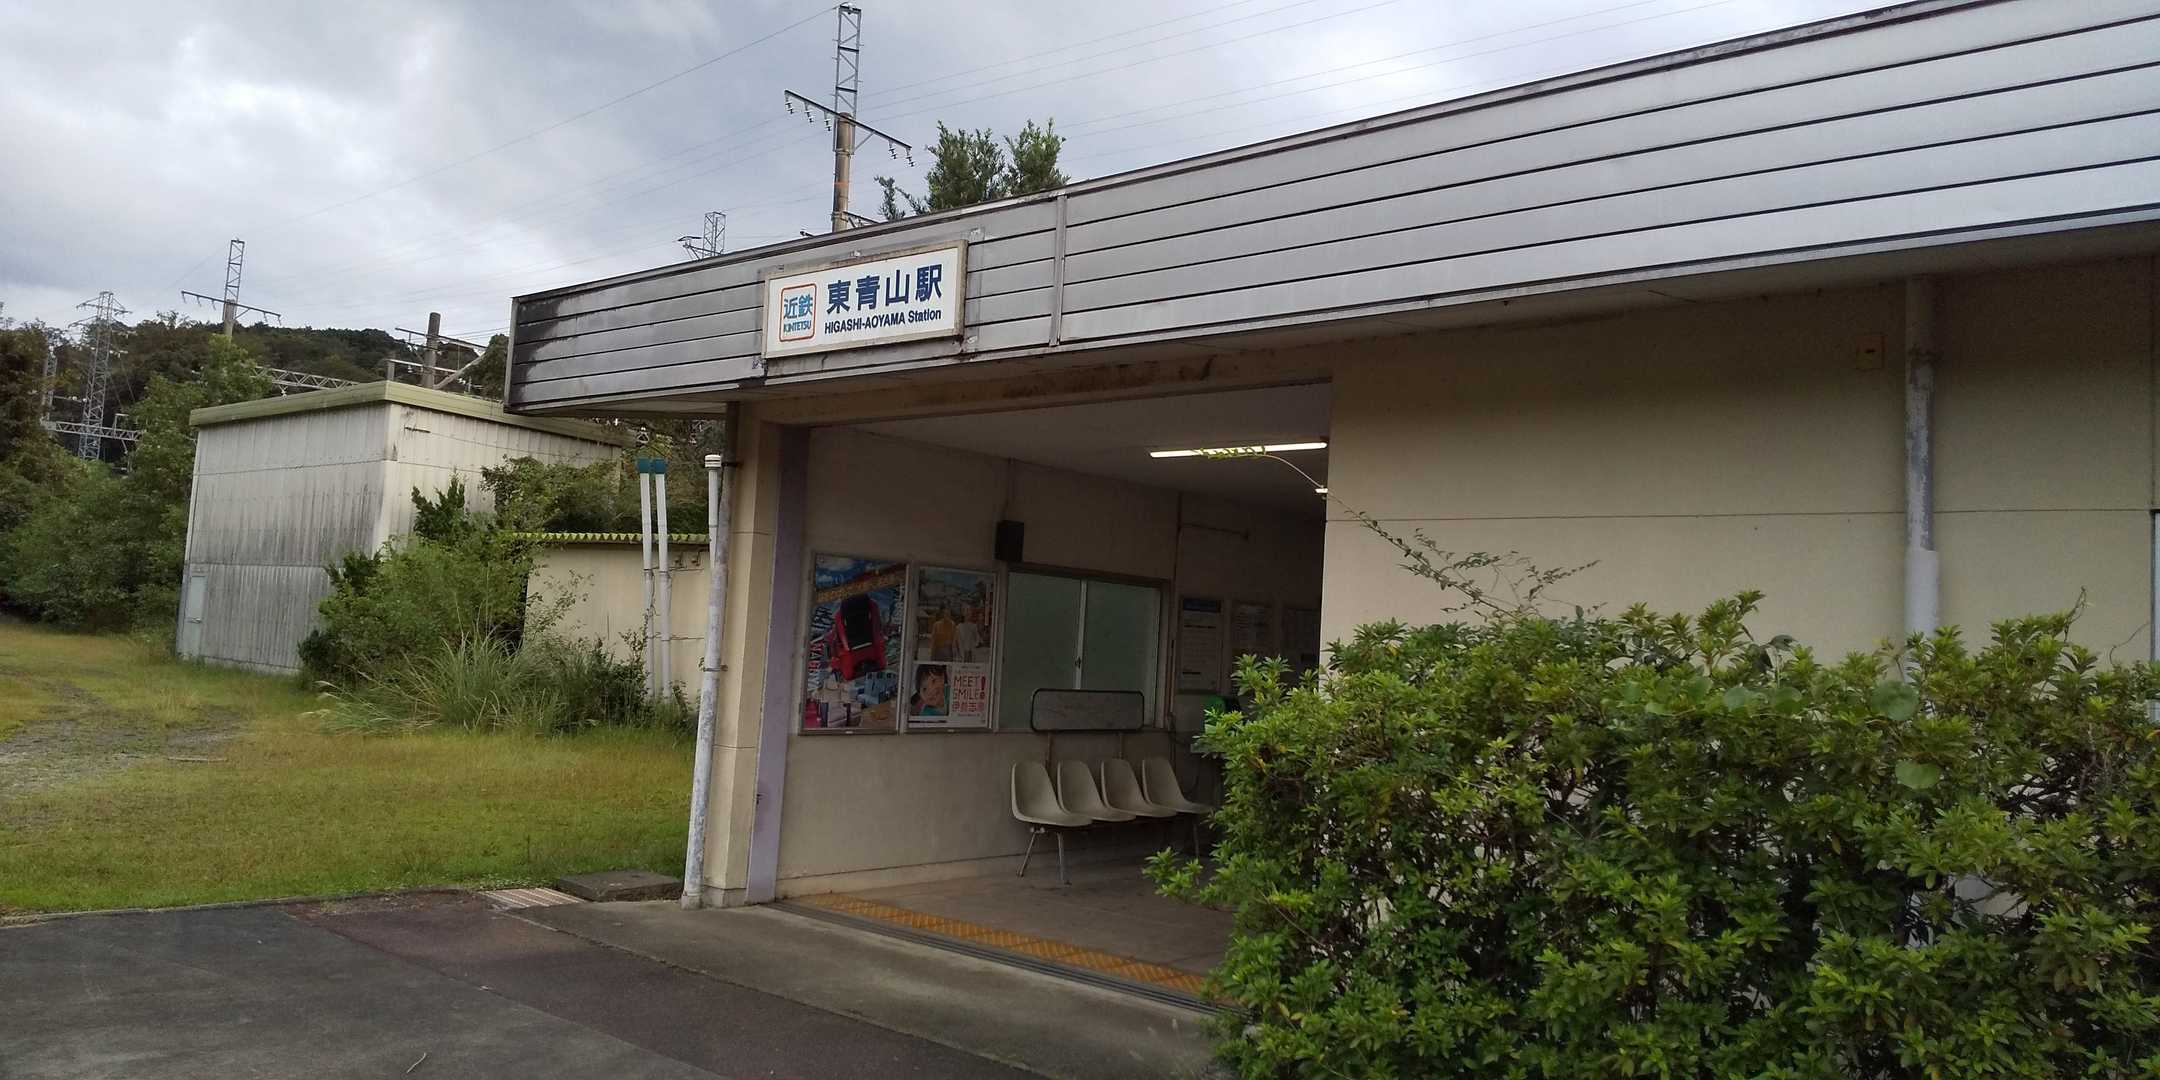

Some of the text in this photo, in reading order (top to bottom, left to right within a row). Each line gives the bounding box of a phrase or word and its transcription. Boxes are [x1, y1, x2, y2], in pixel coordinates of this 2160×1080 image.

[826, 264, 943, 315] 東青山駅
[784, 293, 813, 320] 近鉄
[783, 320, 812, 333] KINTETSU
[824, 308, 942, 335] HIGASHI-AOYAMA Station
